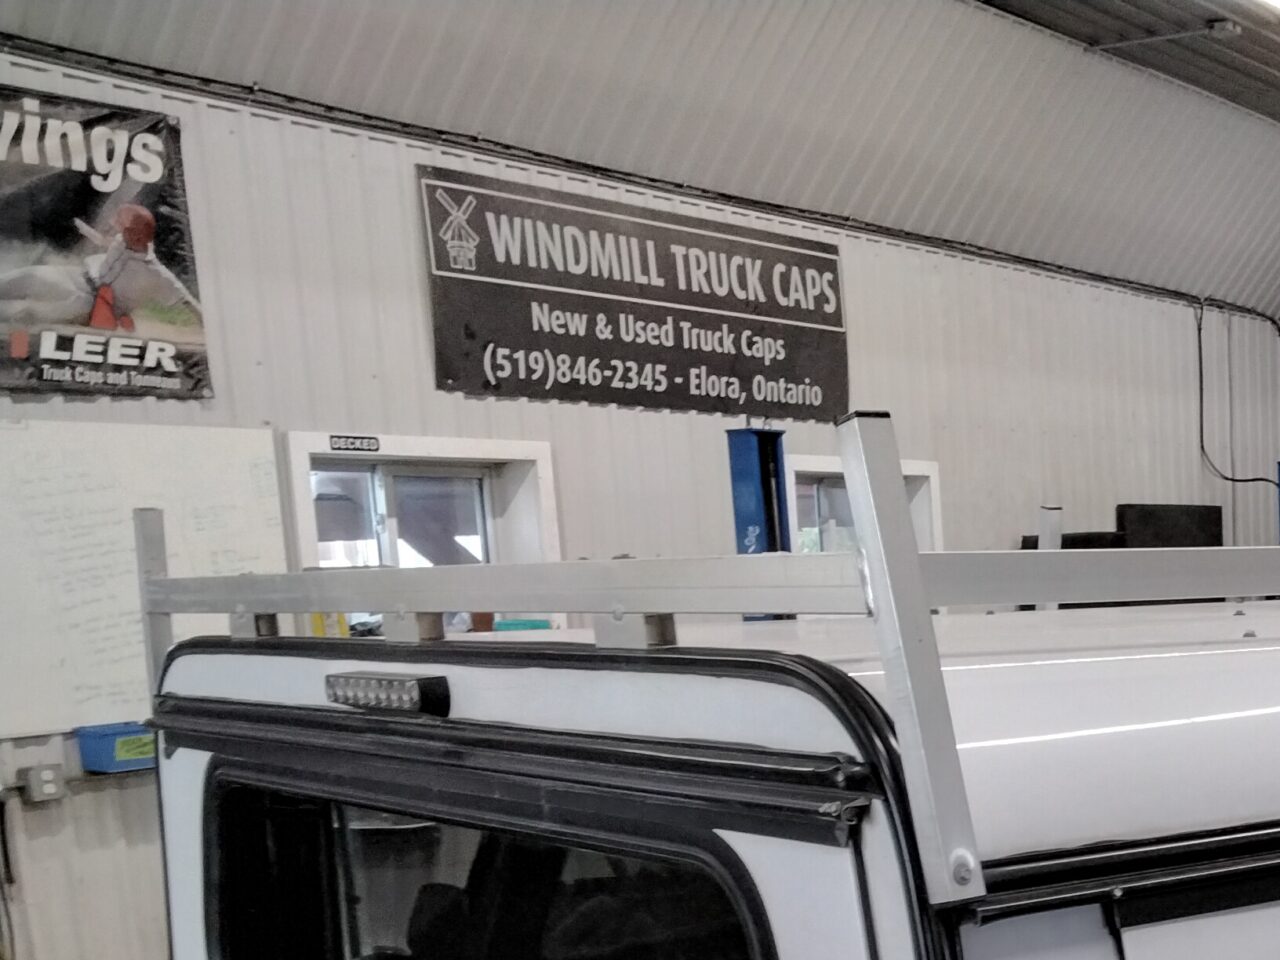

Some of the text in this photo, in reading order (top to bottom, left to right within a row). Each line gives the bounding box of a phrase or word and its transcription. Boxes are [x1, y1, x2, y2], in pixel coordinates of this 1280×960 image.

[485, 211, 837, 313] WINDMILL TRUCK CAPS
[39, 330, 179, 372] LEER
[531, 302, 786, 366] New & Used Truck Caps
[41, 363, 72, 380] Truck
[483, 343, 668, 392] (519)846-2345
[689, 367, 747, 406] Elora,
[752, 375, 823, 407] Ontario
[331, 437, 378, 450] DECKED
